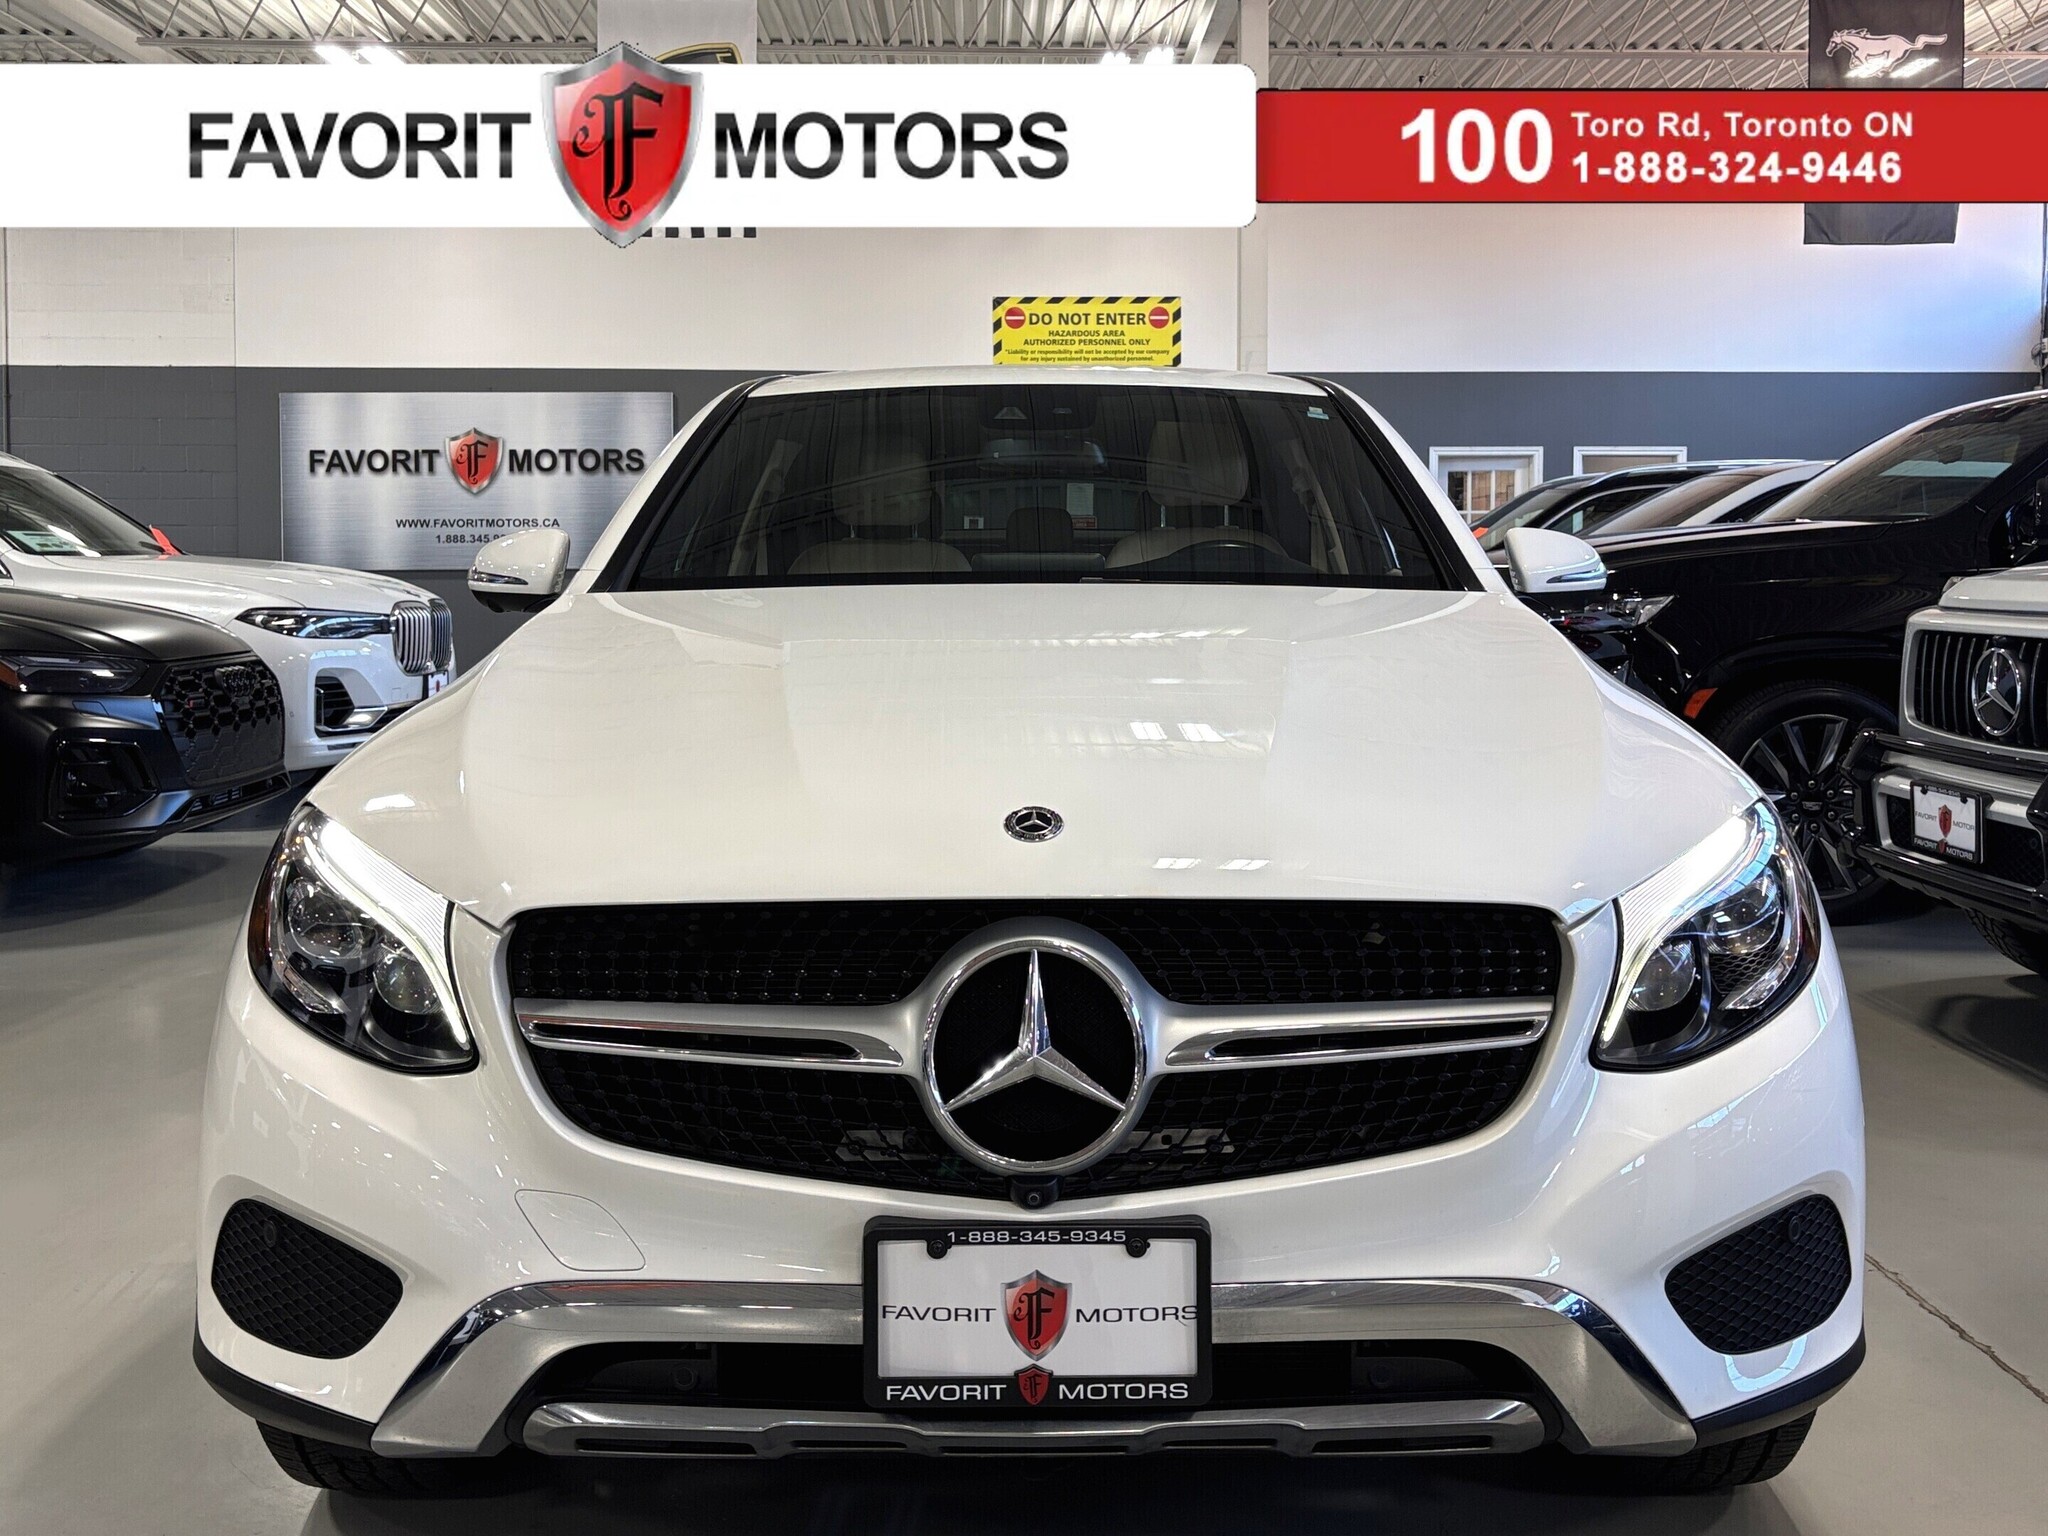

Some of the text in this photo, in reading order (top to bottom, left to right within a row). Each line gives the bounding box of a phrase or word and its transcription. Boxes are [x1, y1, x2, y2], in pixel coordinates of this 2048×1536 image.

[1029, 313, 1146, 325] DO NOT ENTER
[309, 449, 440, 474] FAVORIT
[508, 448, 645, 474] MOTORS
[396, 518, 560, 529] WWW.FAVORITMOTORS.CA
[947, 1230, 1126, 1243] 1-888-345-9345
[881, 1305, 997, 1323] FAVORIT
[1076, 1305, 1197, 1323] MOTORS
[886, 1384, 1007, 1401] FAVORIT
[1059, 1383, 1189, 1400] MOTORS
